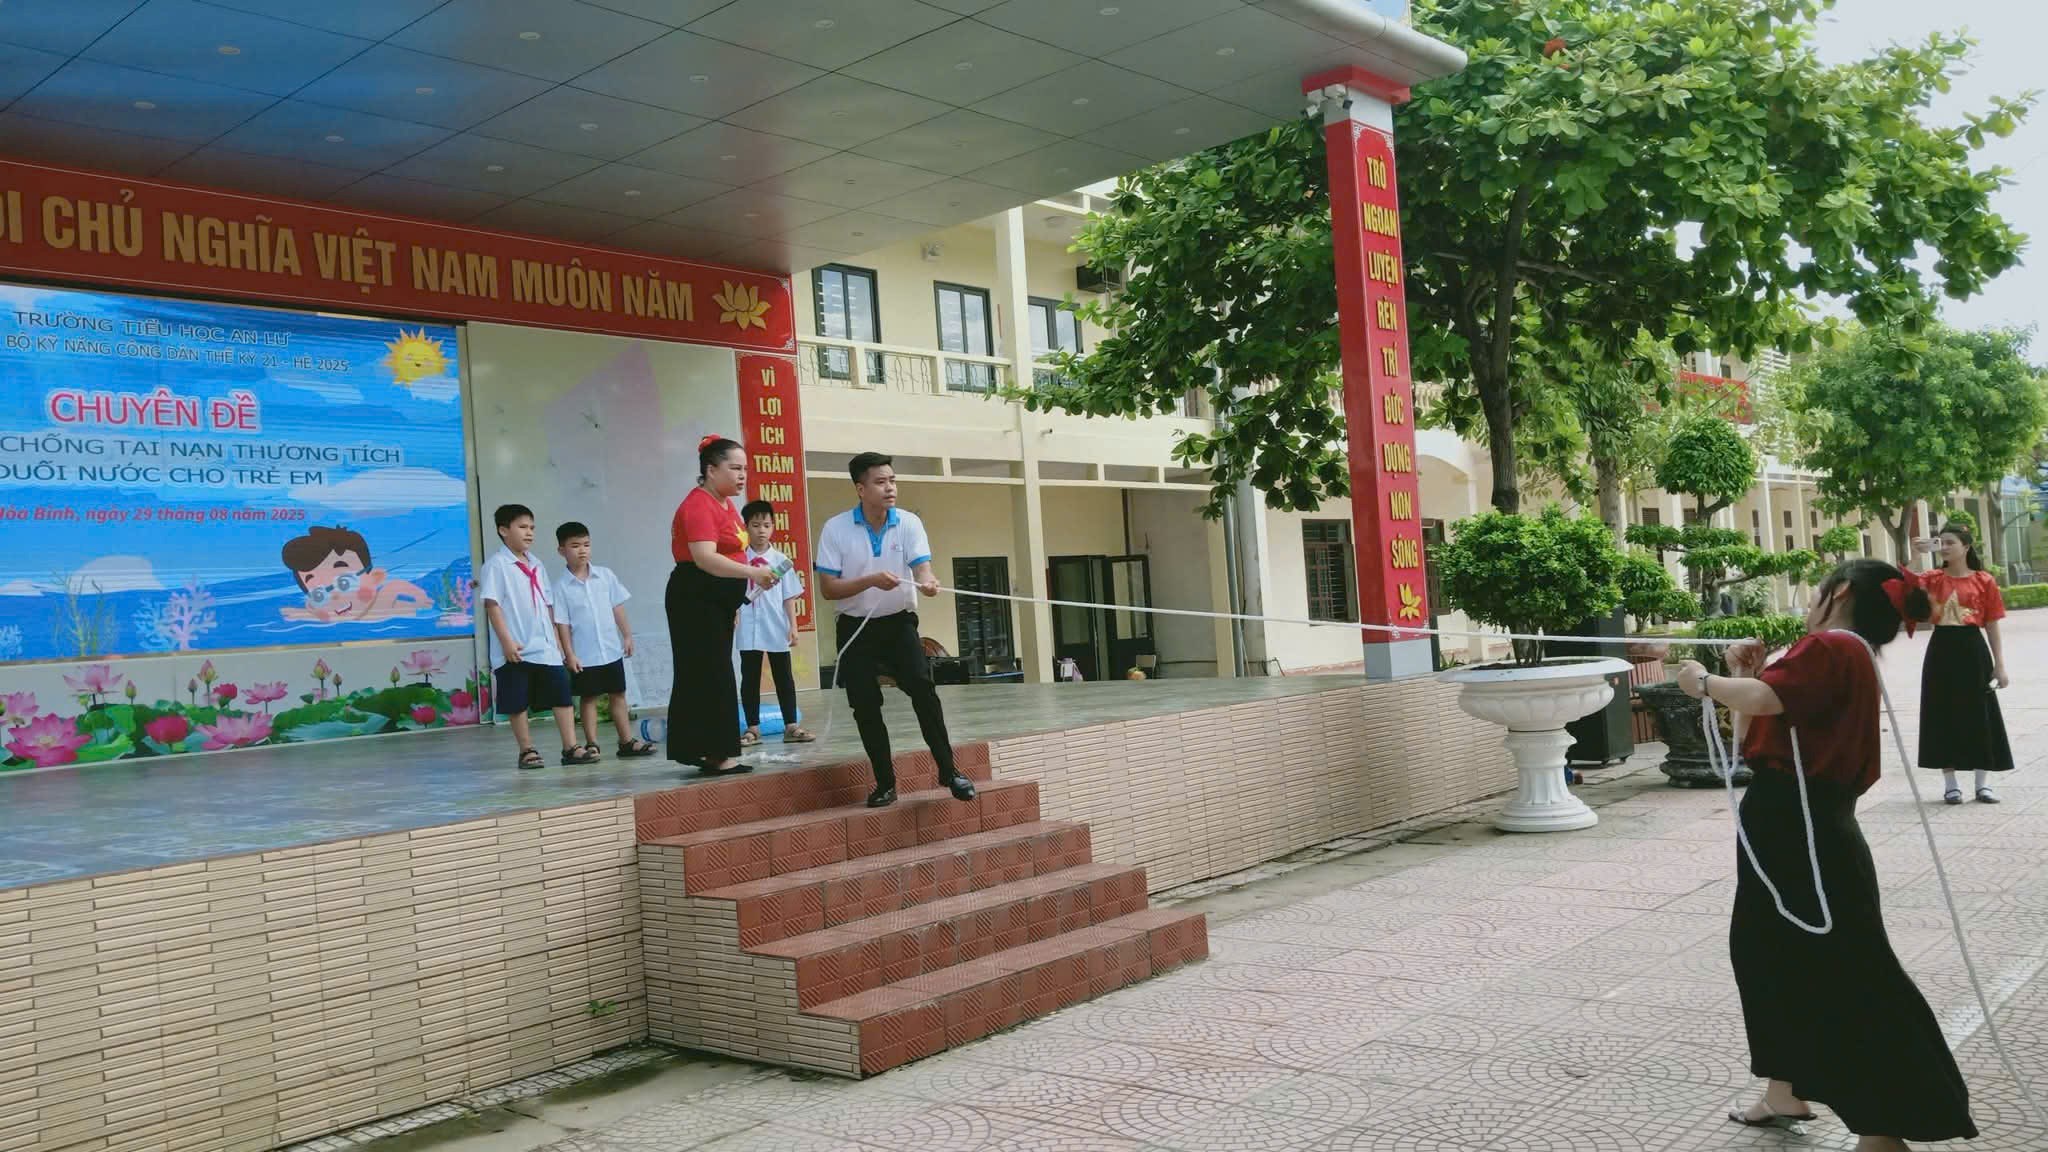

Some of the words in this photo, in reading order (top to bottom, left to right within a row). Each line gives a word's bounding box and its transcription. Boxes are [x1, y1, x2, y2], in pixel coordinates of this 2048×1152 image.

[1366, 154, 1388, 190] TRÒ
[1363, 202, 1398, 238] NGOAN
[0, 190, 23, 244] I
[42, 188, 144, 258] CHỦ
[162, 211, 302, 276] NGHĨA
[312, 228, 397, 295] VIỆT
[411, 245, 498, 299] NAM
[511, 258, 613, 313] MUÔN
[622, 269, 694, 322] NĂM
[1368, 250, 1399, 289] LUYỆN
[13, 310, 113, 332] TRƯỜNG
[178, 324, 225, 343] HỌC
[231, 329, 257, 344] AN
[264, 331, 292, 346] LƯ
[1376, 296, 1398, 331] RÈN
[6, 331, 31, 350] BỘ
[37, 334, 58, 350] KỸ
[116, 338, 162, 359] CÔNG
[262, 354, 278, 367] 21
[317, 358, 349, 372] 2025
[1381, 342, 1399, 377] TRÍ
[761, 366, 776, 388] VÌ
[51, 389, 198, 427] CHUYÊN
[211, 393, 257, 430] ĐỀ
[759, 397, 782, 420] LỢI
[0, 433, 105, 455] CHỐNG
[113, 440, 160, 457] TAI
[170, 441, 222, 461] NẠN
[232, 444, 338, 462] THƯƠNG
[345, 444, 400, 463] TÍCH
[760, 425, 785, 445] ÍCH
[78, 462, 161, 482] NƯỚC
[169, 467, 225, 484] CHO
[232, 467, 281, 485] TRẺ
[290, 471, 323, 485] EM
[753, 451, 795, 474] TRĂM
[1382, 441, 1412, 480] DỰNG
[759, 481, 793, 502] NĂM
[1389, 491, 1412, 520] NON
[134, 508, 154, 521] 29
[157, 506, 205, 523] tháng
[209, 508, 228, 521] 08
[271, 508, 305, 521] 2025
[775, 510, 790, 531] HÌ
[1391, 533, 1419, 569] SÔNG
